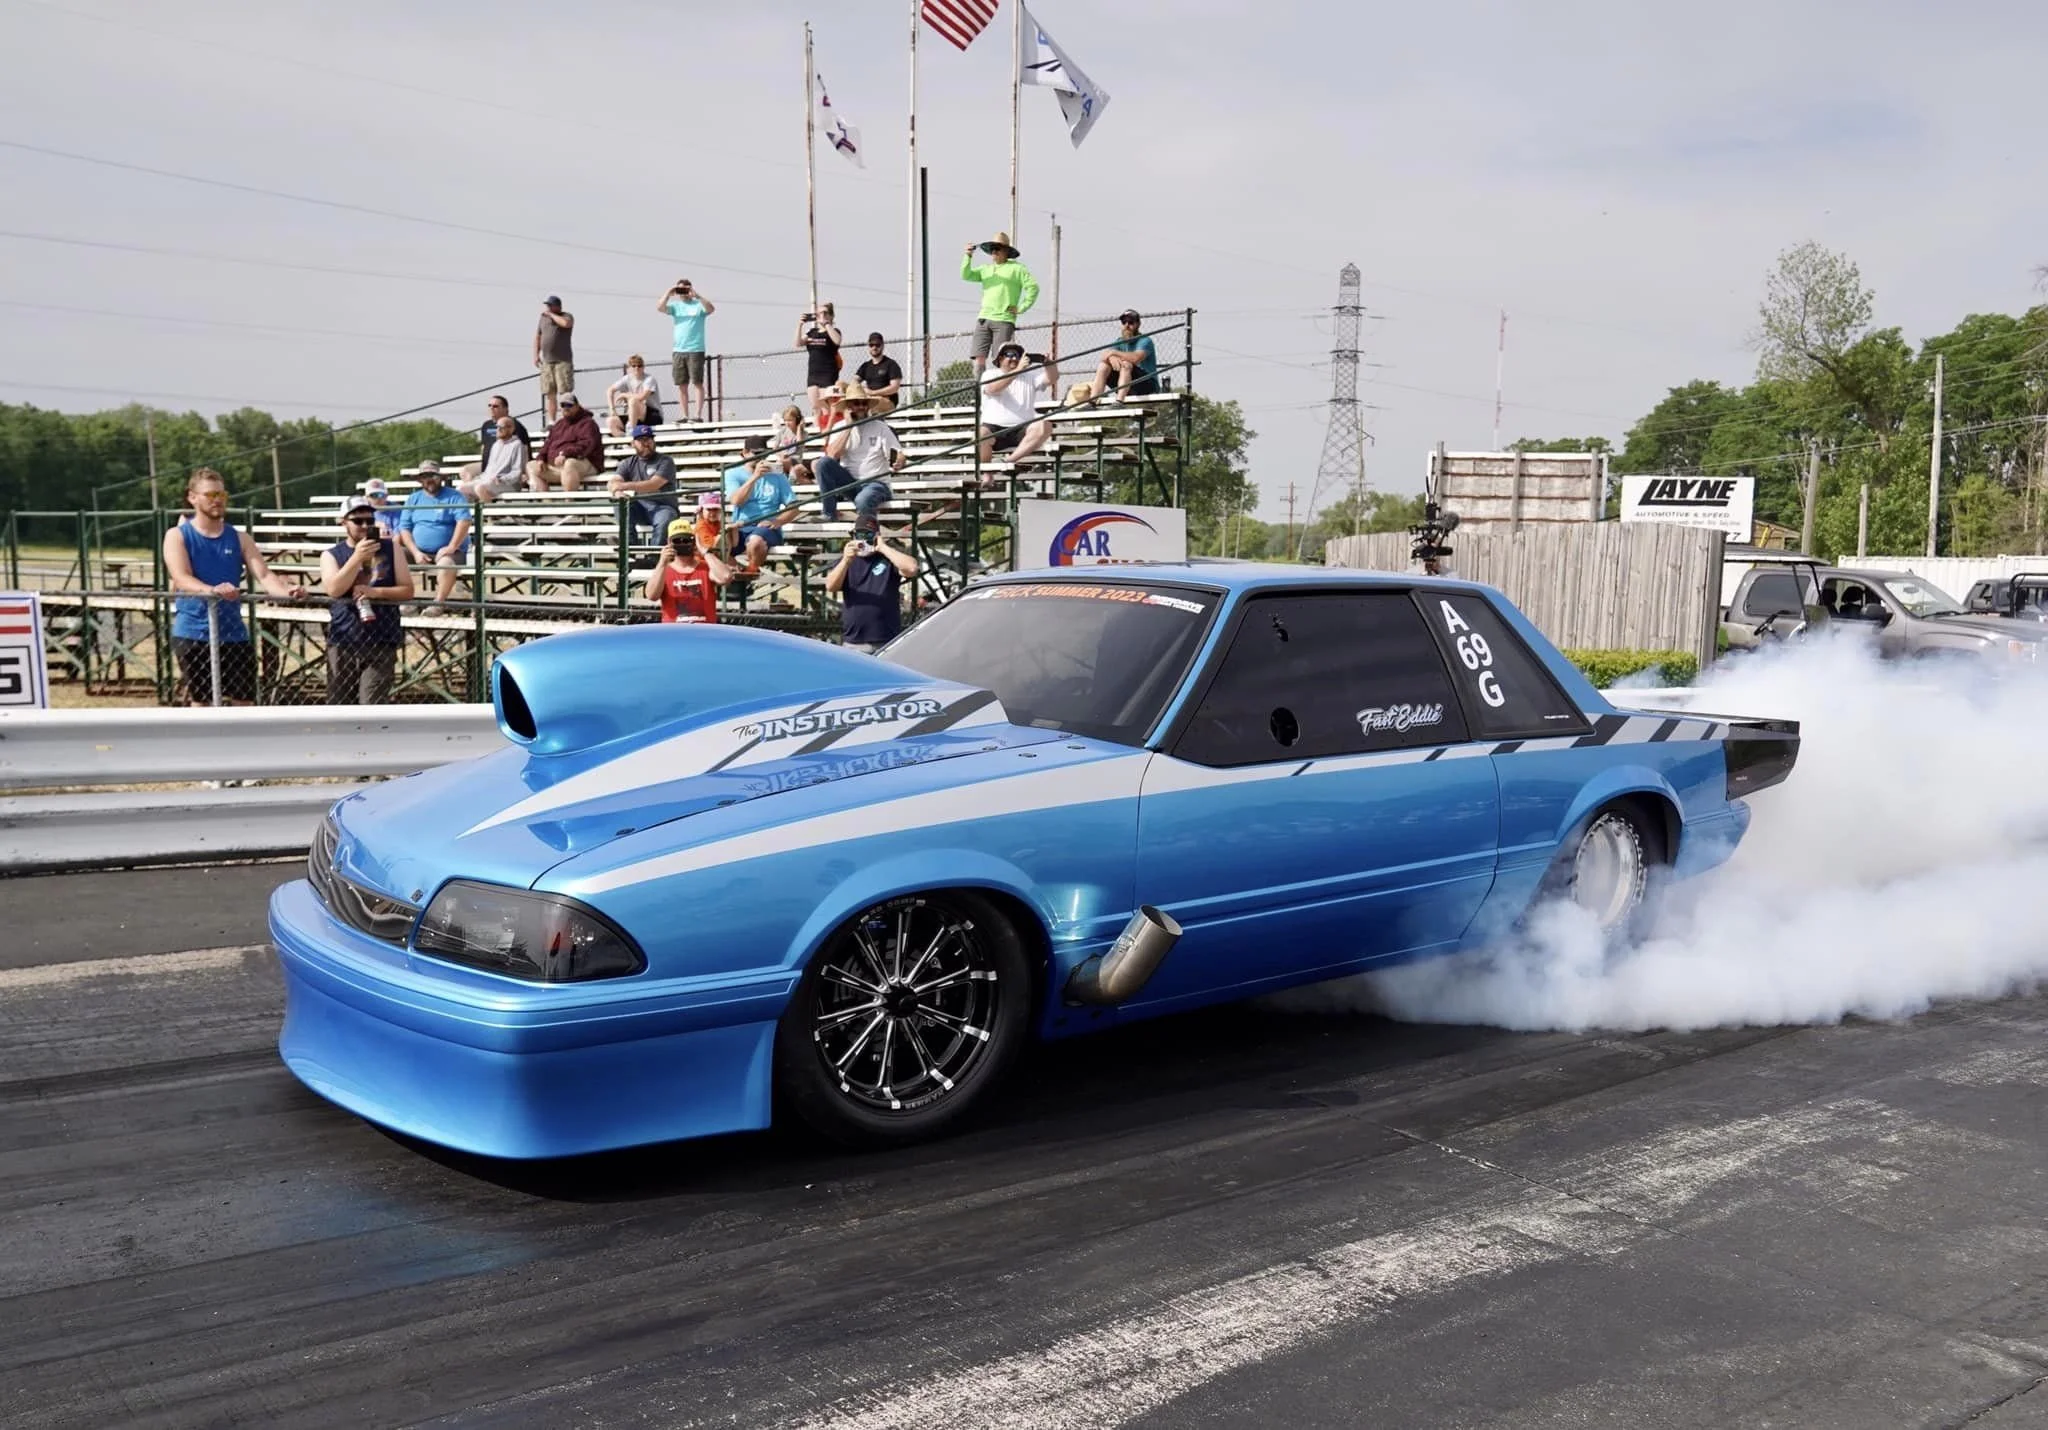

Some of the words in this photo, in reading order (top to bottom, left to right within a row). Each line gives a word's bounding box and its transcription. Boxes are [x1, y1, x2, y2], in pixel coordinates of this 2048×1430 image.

[1638, 479, 1738, 507] LAYNE
[1702, 511, 1730, 519] SPEED
[1058, 529, 1112, 557] CAR
[1033, 586, 1102, 599] SUMMER
[1102, 588, 1147, 603] 2023
[1440, 600, 1470, 634] A
[1457, 633, 1493, 670] 69
[1479, 670, 1505, 708] G
[732, 724, 759, 740] The
[762, 699, 943, 741] INSTIGATOR
